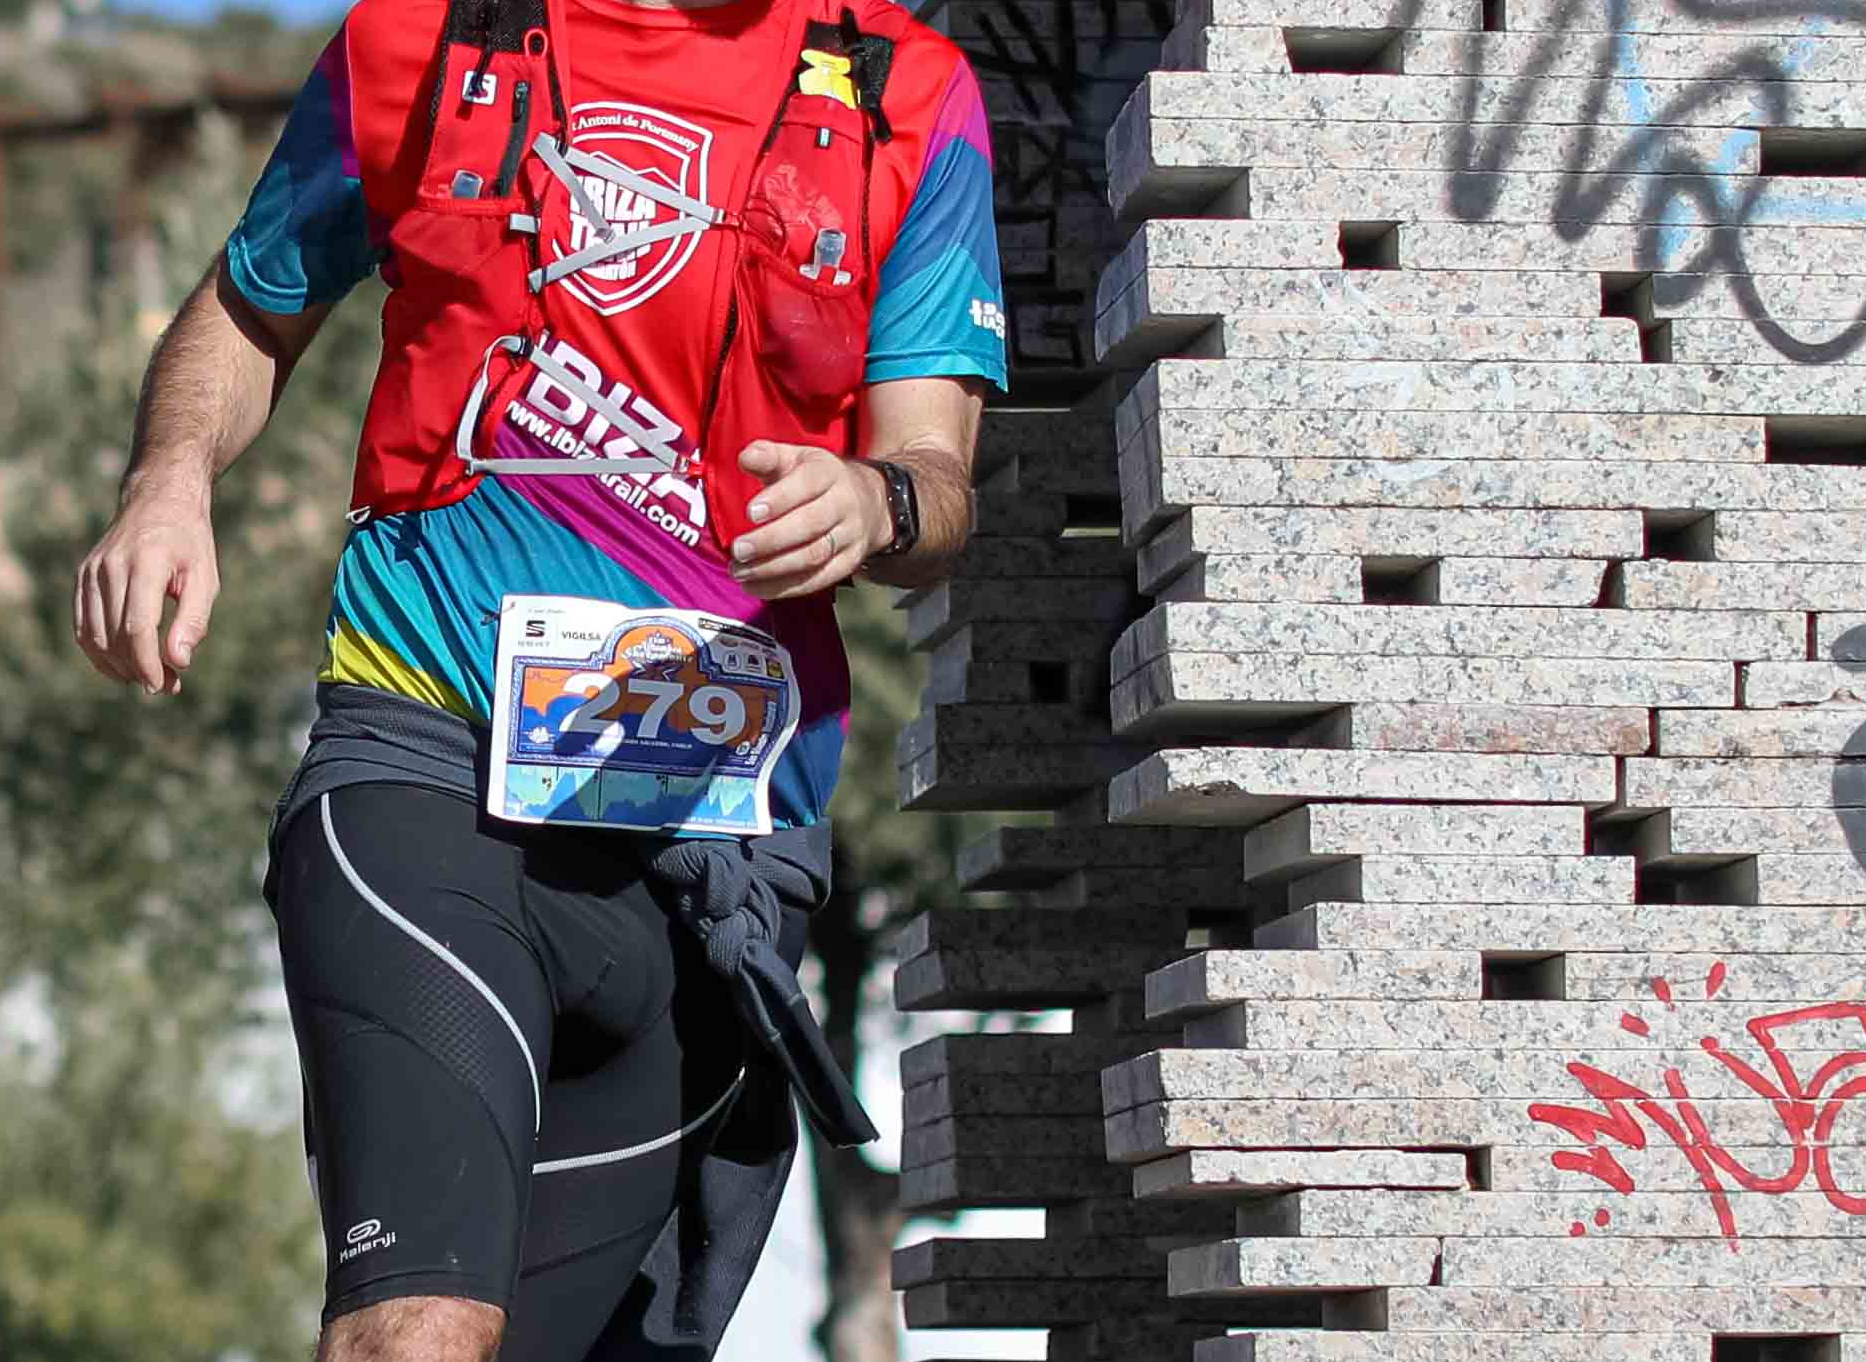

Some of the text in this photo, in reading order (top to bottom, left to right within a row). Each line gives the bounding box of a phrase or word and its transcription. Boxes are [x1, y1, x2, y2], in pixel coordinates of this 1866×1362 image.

[577, 113, 622, 131] Antoni
[622, 113, 639, 128] de
[560, 672, 746, 745] 279
